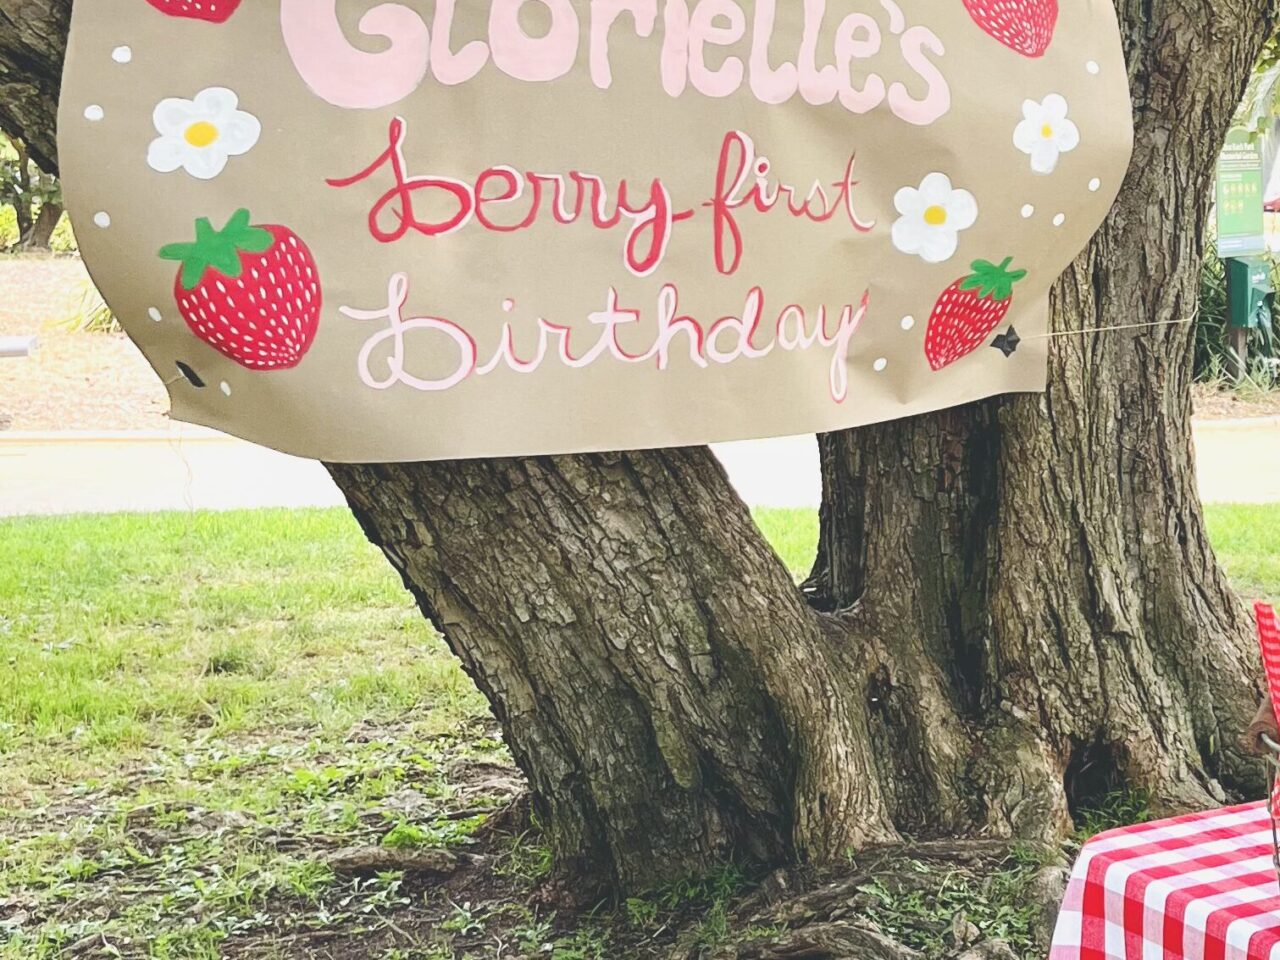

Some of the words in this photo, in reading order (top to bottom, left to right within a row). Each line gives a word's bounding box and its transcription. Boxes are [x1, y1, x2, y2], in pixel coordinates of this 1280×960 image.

[325, 116, 694, 277] berry
[702, 130, 878, 276] first
[338, 271, 870, 403] birthday
